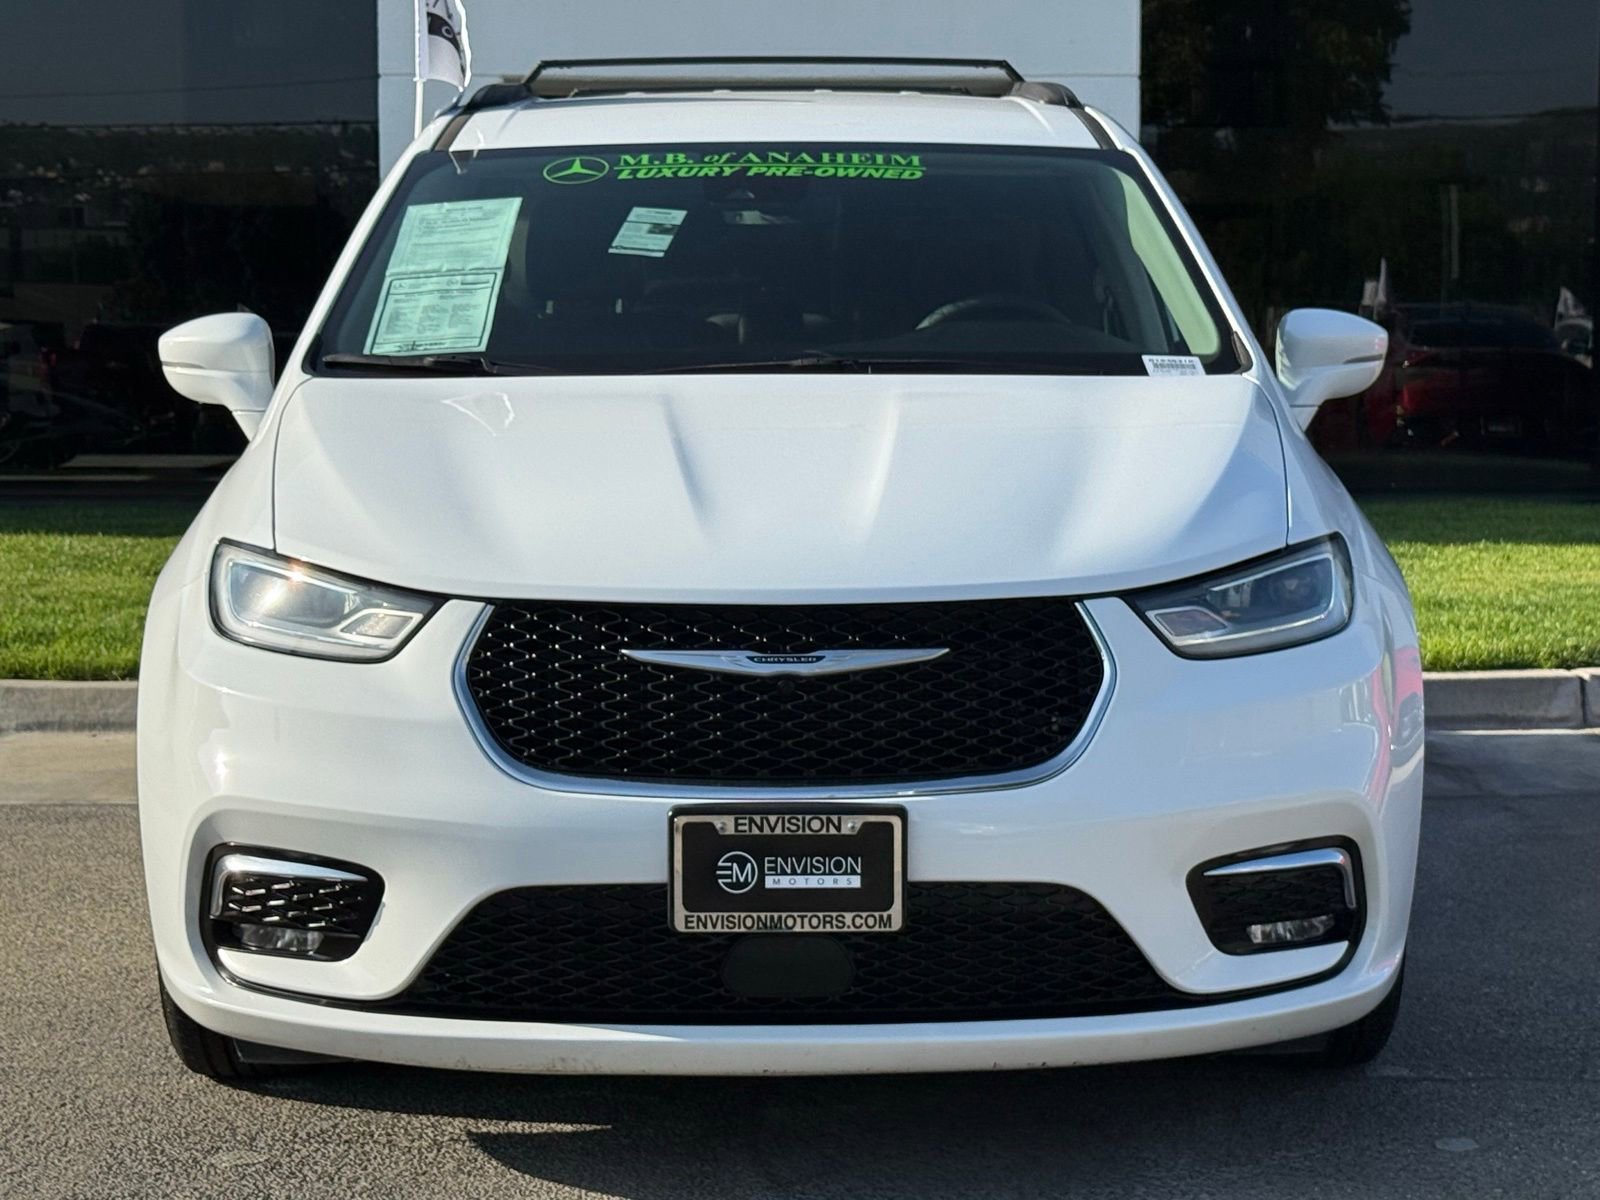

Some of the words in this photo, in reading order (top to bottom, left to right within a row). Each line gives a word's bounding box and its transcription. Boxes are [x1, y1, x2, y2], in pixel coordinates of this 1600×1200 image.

[620, 153, 694, 166] M.B.
[703, 152, 737, 165] of
[738, 152, 920, 166] ANAHEIM
[617, 166, 742, 180] LUXURY
[746, 166, 923, 180] PRE-OWNED
[734, 816, 842, 833] ENVISION
[764, 856, 862, 875] ENVISION
[772, 877, 853, 886] MOTORS
[684, 913, 892, 931] ENVISIONMOTORS.COM
